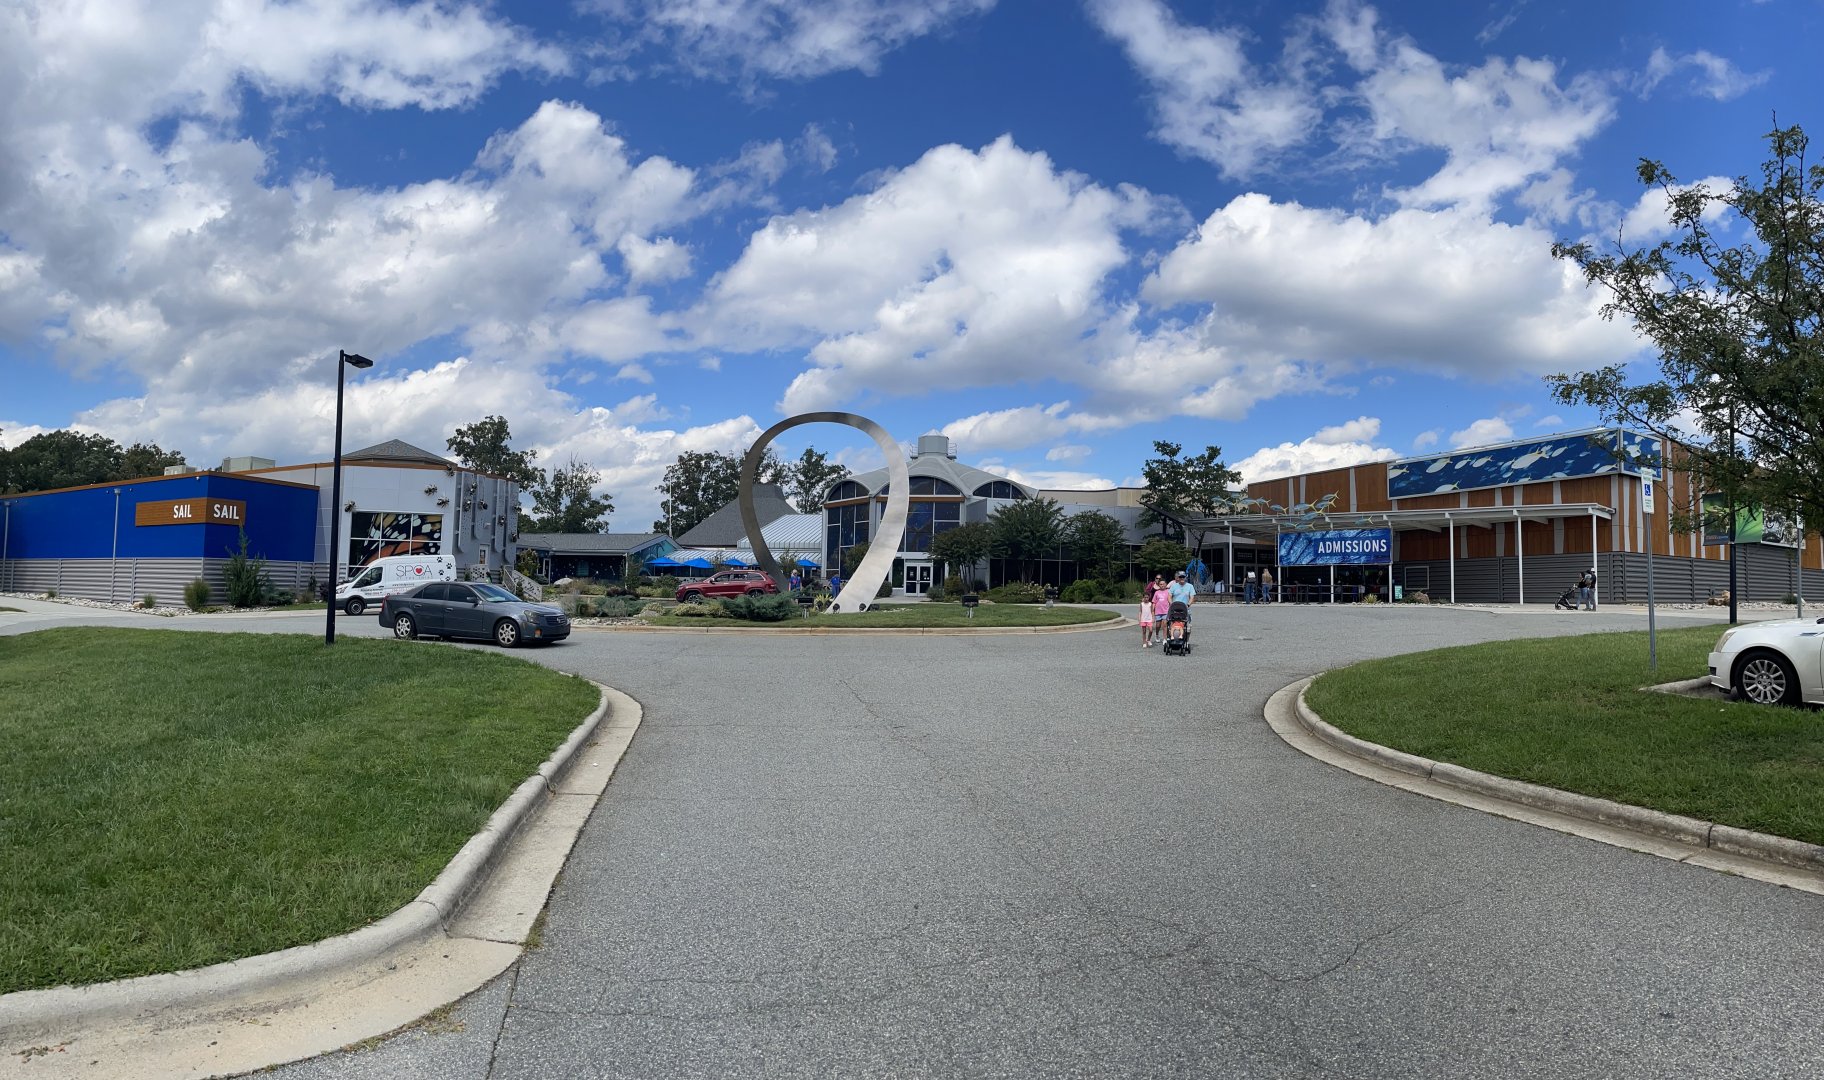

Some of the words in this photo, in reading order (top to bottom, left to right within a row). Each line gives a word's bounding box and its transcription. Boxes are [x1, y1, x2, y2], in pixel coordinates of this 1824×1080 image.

[173, 503, 192, 519] SAIL
[213, 503, 240, 520] SAIL
[1317, 539, 1387, 554] ADMISSIONS
[395, 564, 433, 577] SPCA
